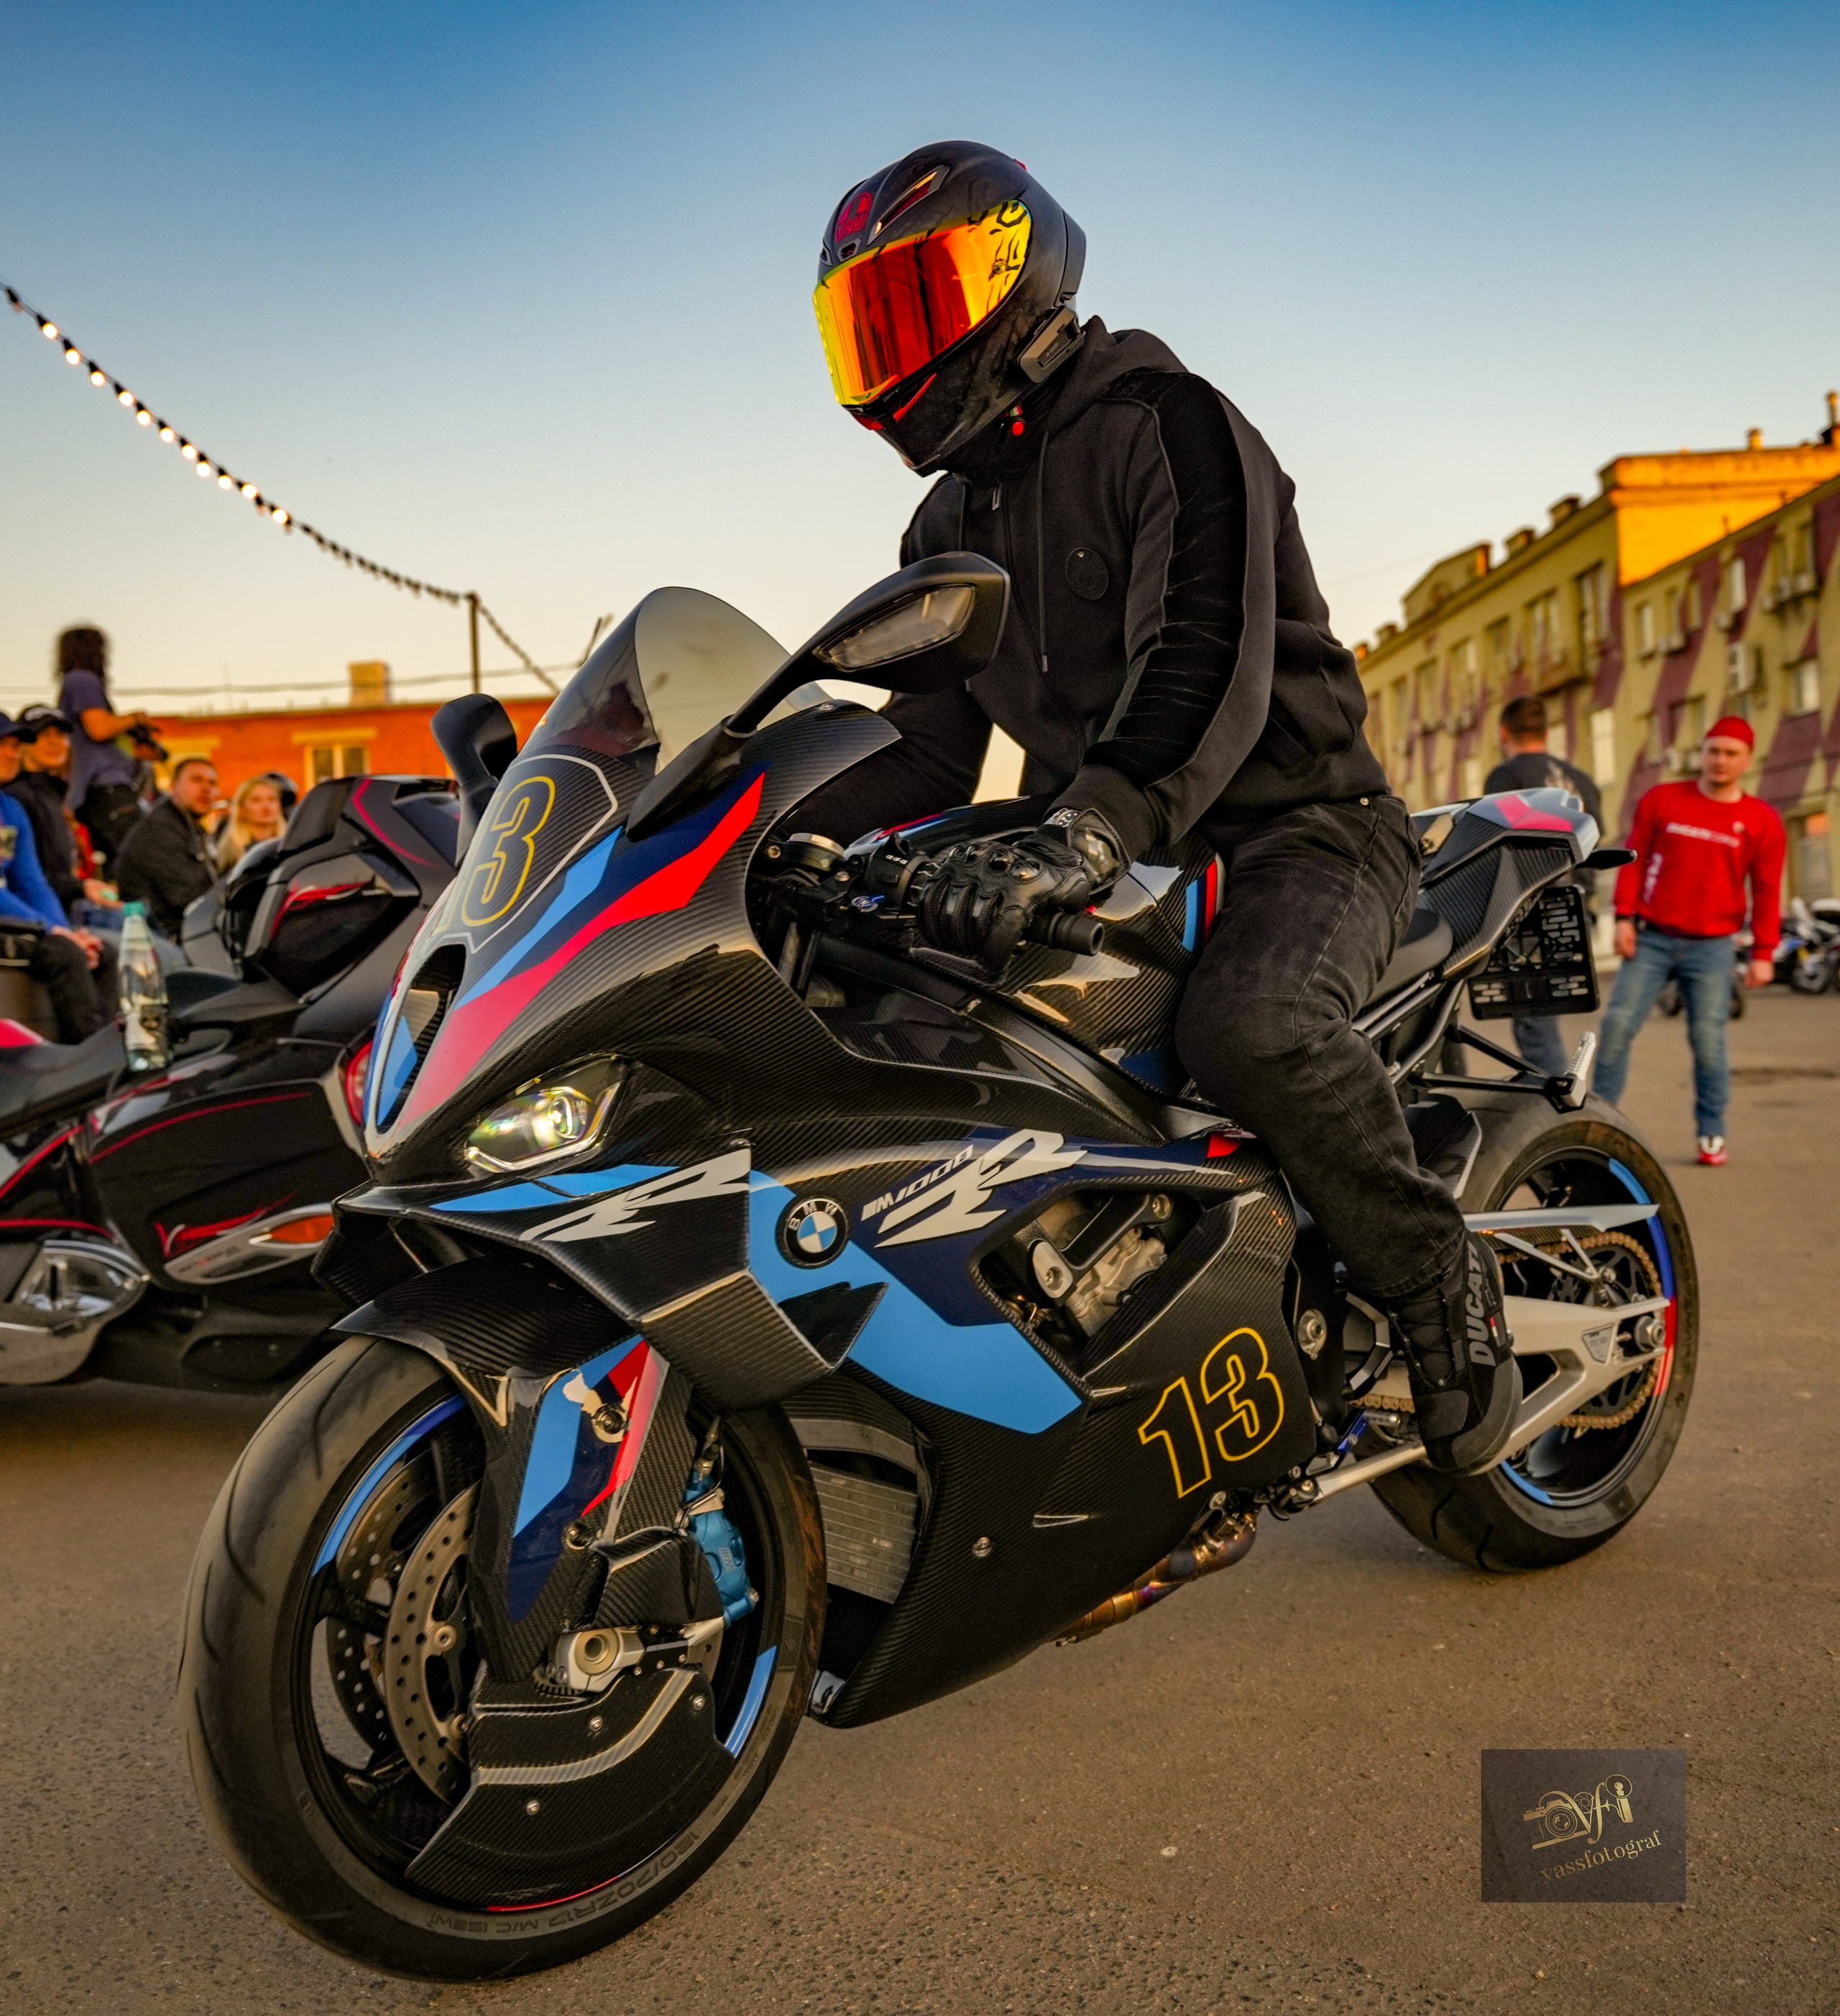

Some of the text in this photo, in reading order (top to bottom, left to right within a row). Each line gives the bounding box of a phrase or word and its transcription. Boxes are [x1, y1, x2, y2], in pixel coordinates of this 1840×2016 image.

[787, 1202, 839, 1231] BMW
[1465, 1241, 1496, 1366] DUCATI
[1137, 1327, 1284, 1499] 13
